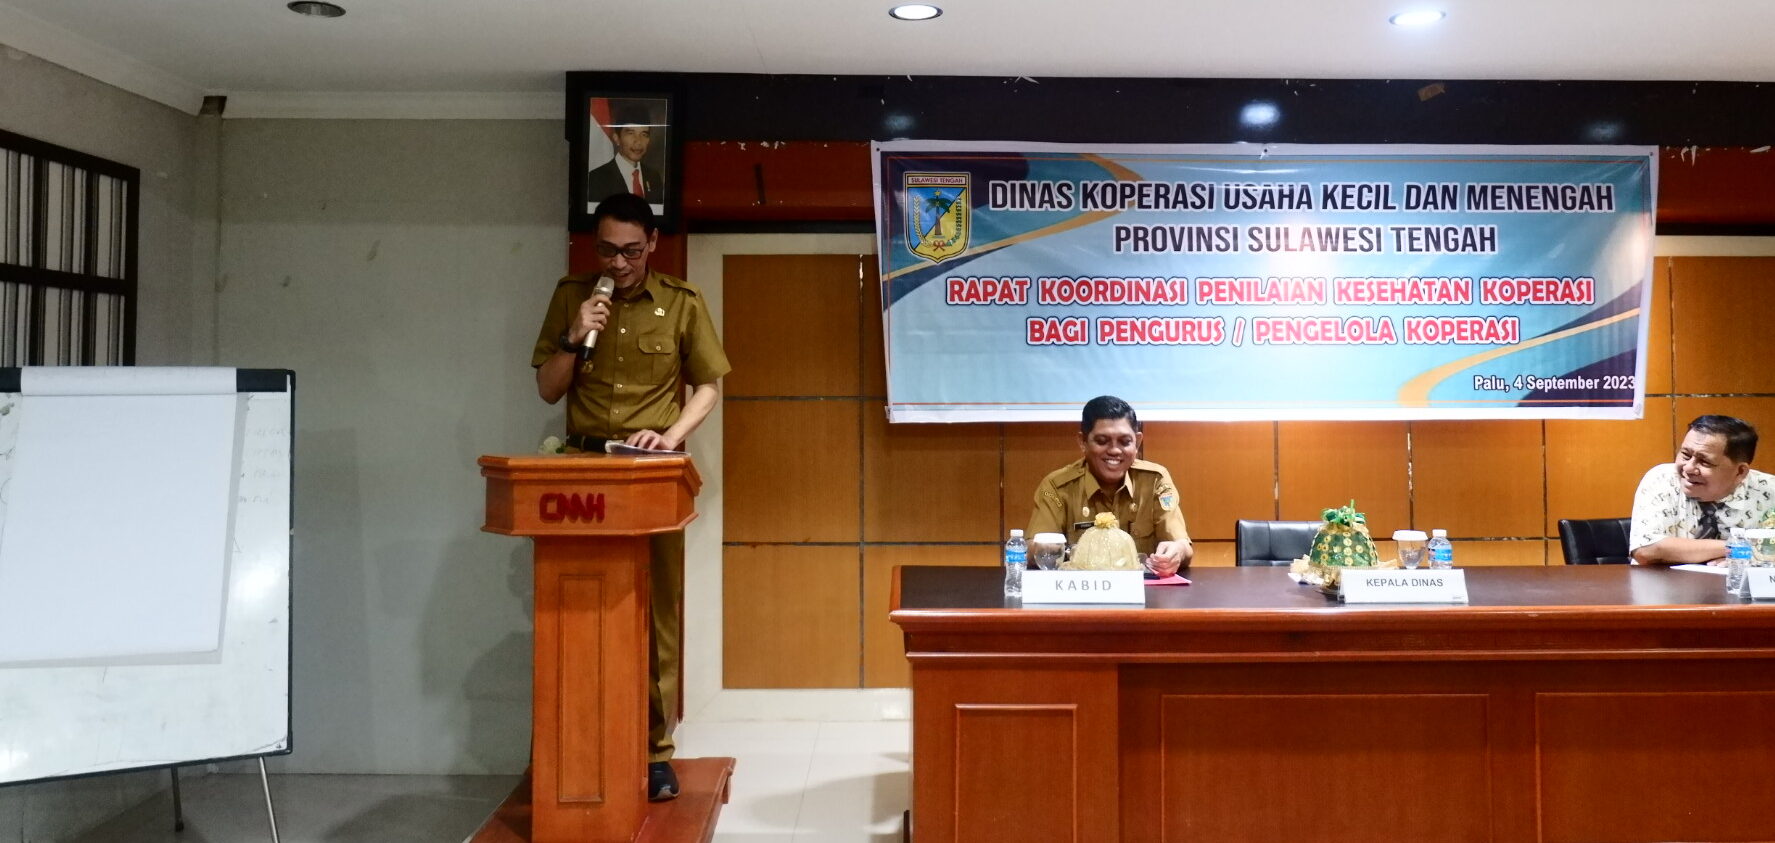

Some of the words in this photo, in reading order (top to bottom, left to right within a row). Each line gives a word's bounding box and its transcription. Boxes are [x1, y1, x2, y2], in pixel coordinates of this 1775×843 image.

[991, 182, 1072, 210] DINAS
[1082, 183, 1214, 210] KOPERASI
[1225, 183, 1312, 210] USAHA
[1322, 184, 1396, 211] KECIL
[1405, 184, 1457, 211] DAN
[1467, 184, 1614, 211] MENENGAH
[1115, 226, 1239, 252] PROVINSI
[1248, 226, 1382, 252] SULAWESI
[1390, 226, 1496, 253] TENGAH
[947, 277, 1030, 304] RAPAT
[1039, 277, 1187, 304] KOORDINASI
[1197, 277, 1325, 304] PENILAIAN
[1335, 277, 1472, 304] KESEHATAN
[1481, 277, 1594, 303] KOPERASI
[1027, 318, 1088, 345] BAGI
[1098, 318, 1224, 345] PENGURUS
[1233, 318, 1245, 346] /
[1254, 317, 1395, 344] PENGELOLA
[1405, 317, 1519, 343] KOPERASI
[1474, 375, 1510, 392] Palu,
[1513, 375, 1523, 390] 4
[1526, 375, 1599, 392] September
[1603, 375, 1635, 390] 2023
[1055, 579, 1112, 591] KABID
[1366, 578, 1409, 587] KEPALA
[1411, 578, 1444, 587] DINAS
